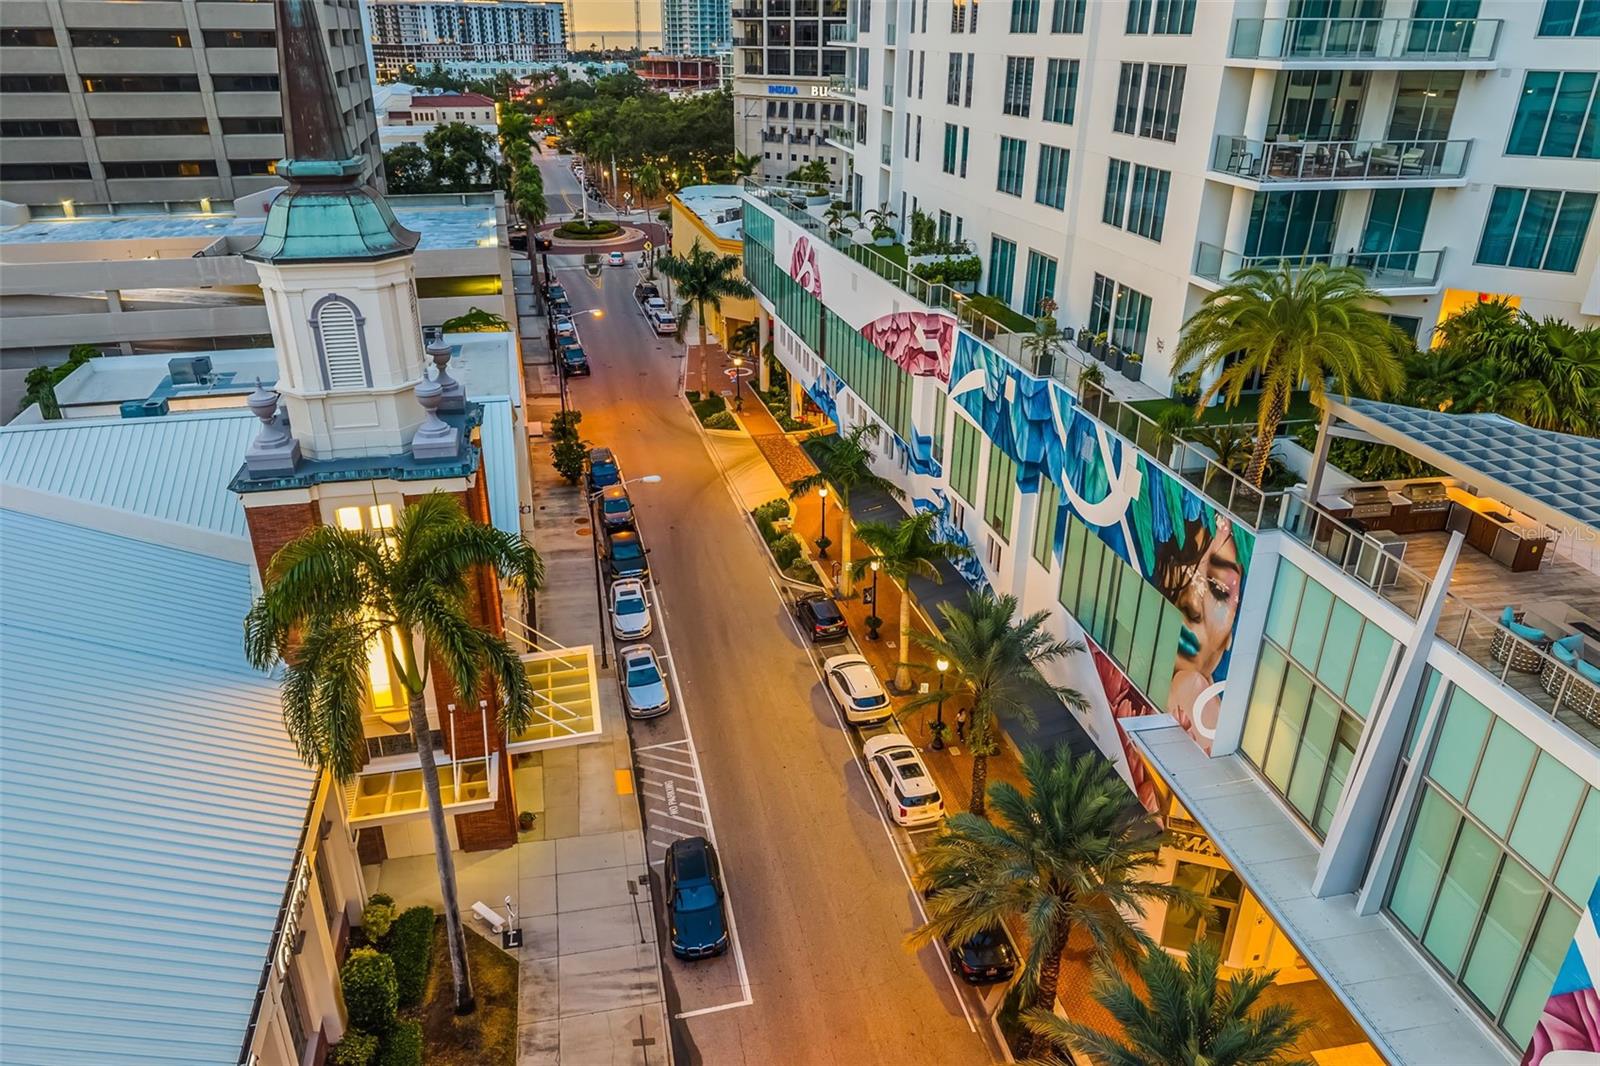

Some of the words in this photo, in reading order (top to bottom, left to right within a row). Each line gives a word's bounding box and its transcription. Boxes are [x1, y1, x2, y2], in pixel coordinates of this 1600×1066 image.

[768, 84, 799, 96] INSULA
[664, 780, 677, 806] PARKING
[669, 805, 679, 816] NO
